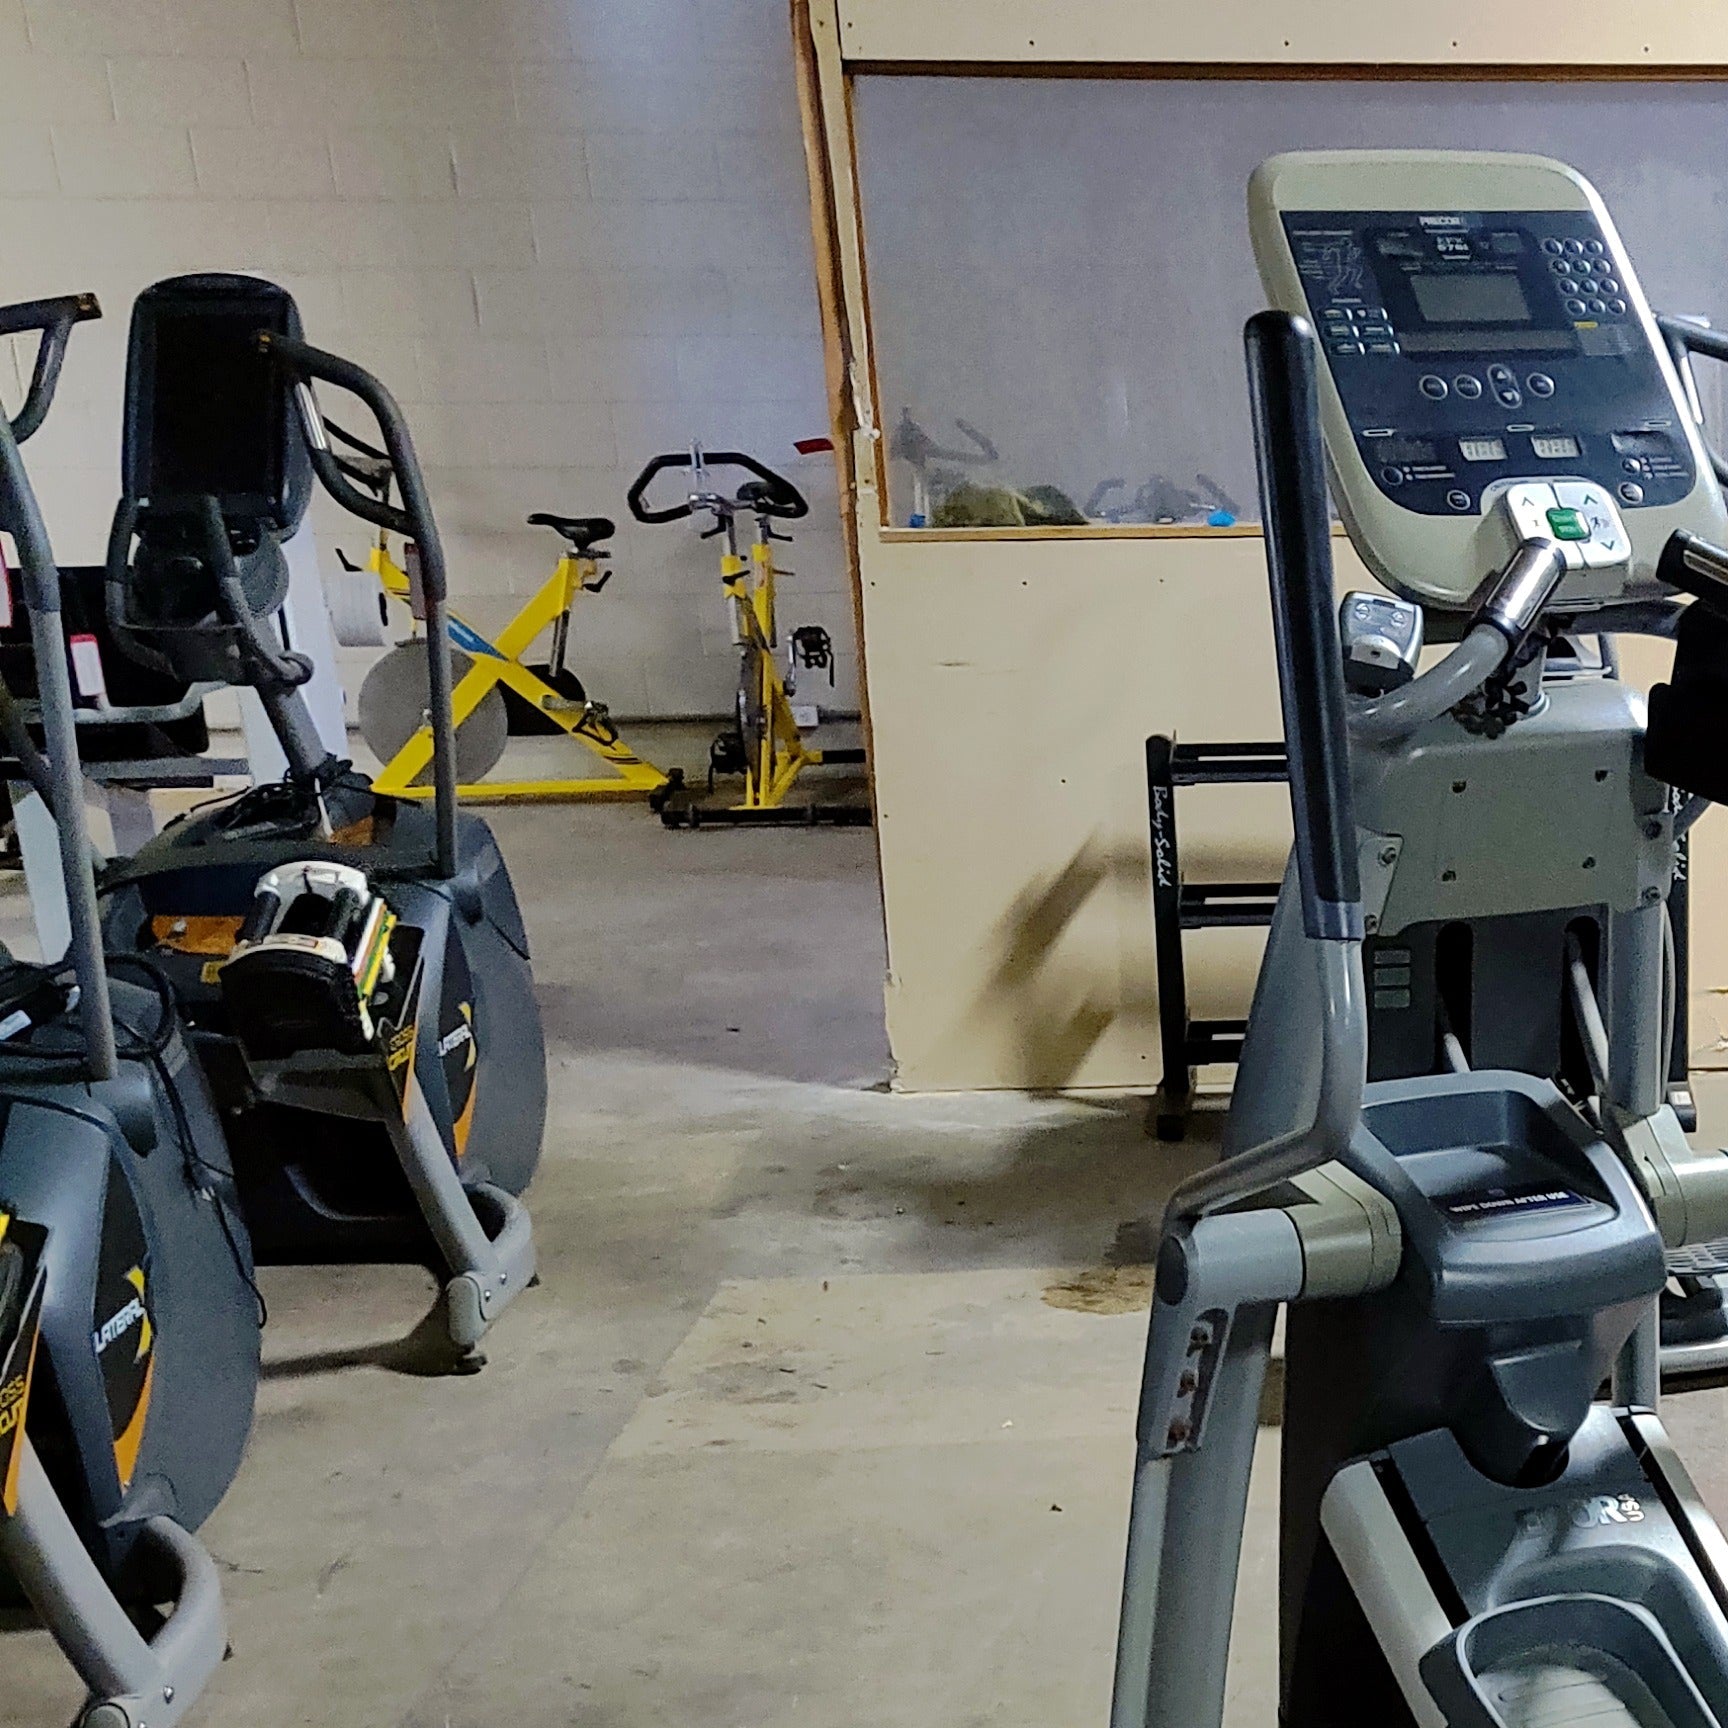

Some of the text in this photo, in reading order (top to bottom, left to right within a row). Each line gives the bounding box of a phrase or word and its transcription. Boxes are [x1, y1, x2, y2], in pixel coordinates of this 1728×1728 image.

[1152, 785, 1172, 887] Body-Solid
[1479, 1199, 1514, 1209] DOWN
[1546, 1191, 1570, 1199] USE
